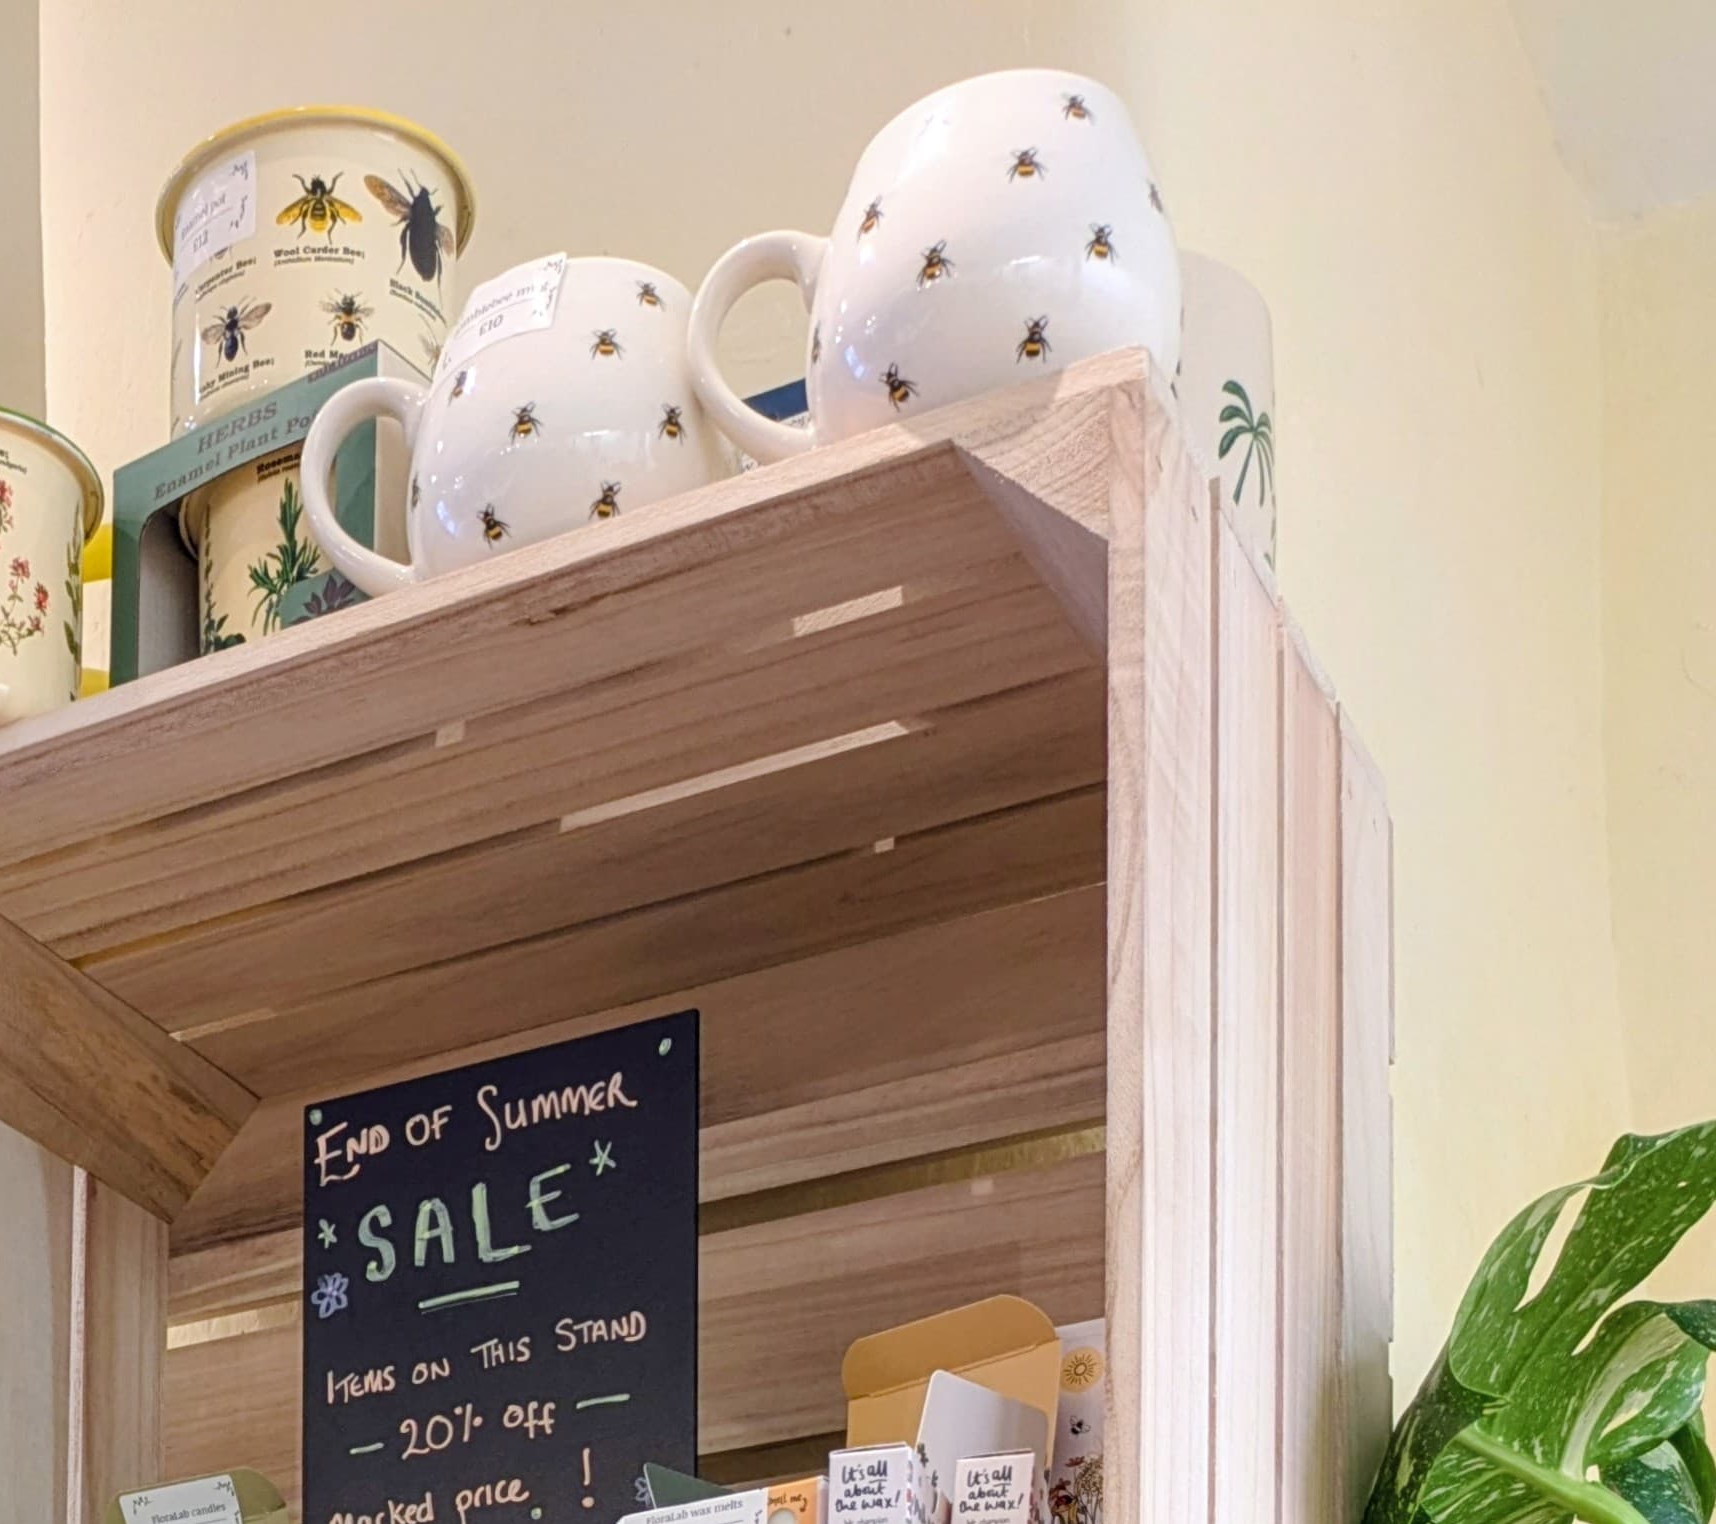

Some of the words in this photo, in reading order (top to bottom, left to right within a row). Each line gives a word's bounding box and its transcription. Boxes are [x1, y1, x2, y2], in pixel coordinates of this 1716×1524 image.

[273, 246, 299, 259] Wool
[302, 245, 340, 256] Carder
[479, 314, 504, 337] £10
[304, 349, 326, 360] Red
[218, 363, 250, 384] Mining
[197, 401, 277, 454] HERBS
[153, 456, 221, 501] Enamel
[227, 430, 278, 462] Plant
[256, 453, 301, 474] Rosema
[406, 1105, 452, 1146] OF
[358, 1163, 579, 1282] SALE
[326, 1366, 395, 1404] ITEMS
[411, 1358, 451, 1385] ON
[471, 1335, 532, 1368] THIS
[555, 1310, 648, 1353] STAND
[400, 1403, 484, 1459] 20%
[867, 1460, 888, 1478] all
[844, 1485, 886, 1498] about
[861, 1490, 901, 1511] wax!
[191, 1502, 226, 1518] candles
[690, 1503, 712, 1518] wax
[714, 1499, 744, 1514] melts
